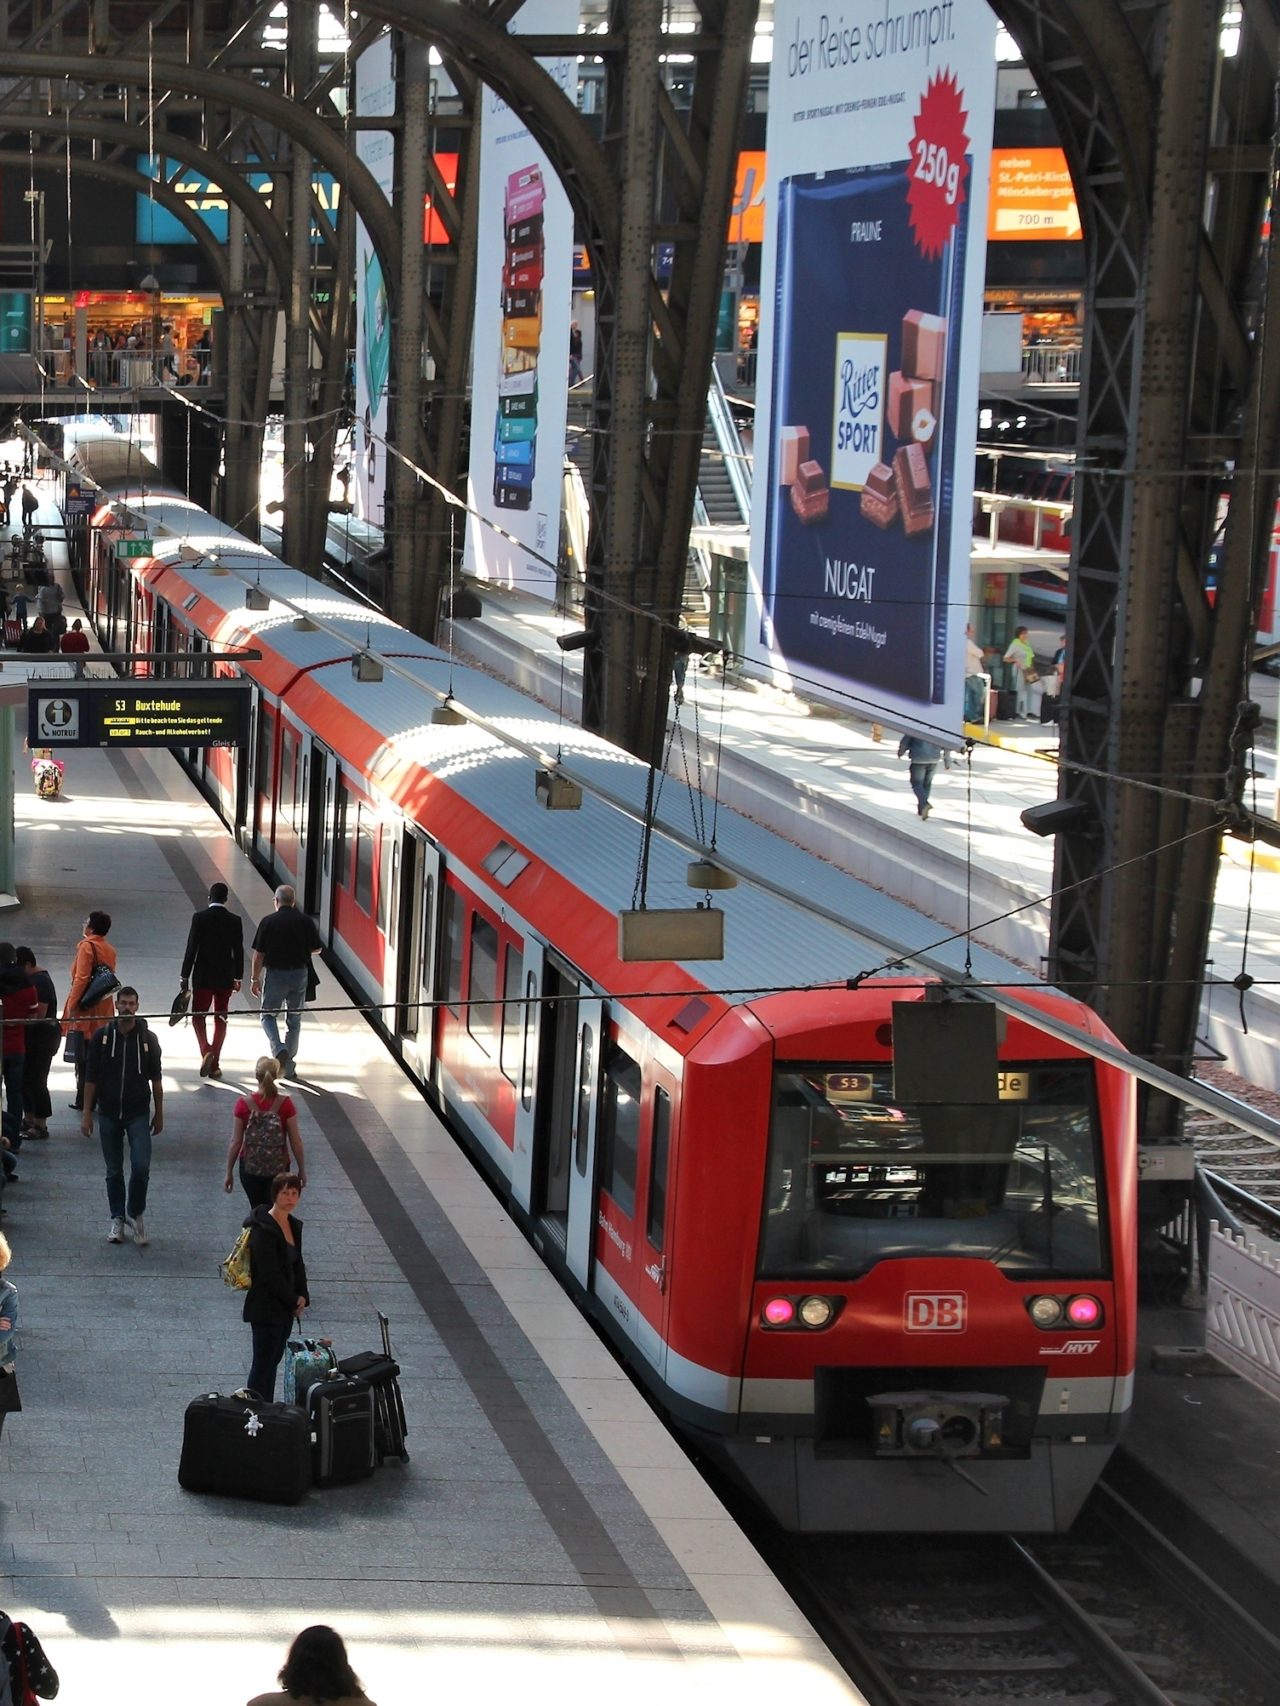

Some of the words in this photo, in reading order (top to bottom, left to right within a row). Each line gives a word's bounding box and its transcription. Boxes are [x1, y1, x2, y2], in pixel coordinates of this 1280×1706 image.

[788, 17, 814, 77] der
[819, 15, 862, 70] Reise
[1000, 158, 1031, 168] neben
[1018, 215, 1040, 225] 700
[1044, 216, 1053, 224] m
[840, 359, 879, 418] Ritter
[838, 421, 878, 453] SPORT
[825, 558, 875, 603] NUGAT
[115, 700, 126, 711] S3
[135, 700, 181, 711] Buxtehude
[840, 1078, 859, 1088] S3
[912, 1299, 959, 1326] DB
[1066, 1343, 1097, 1354] HVV
